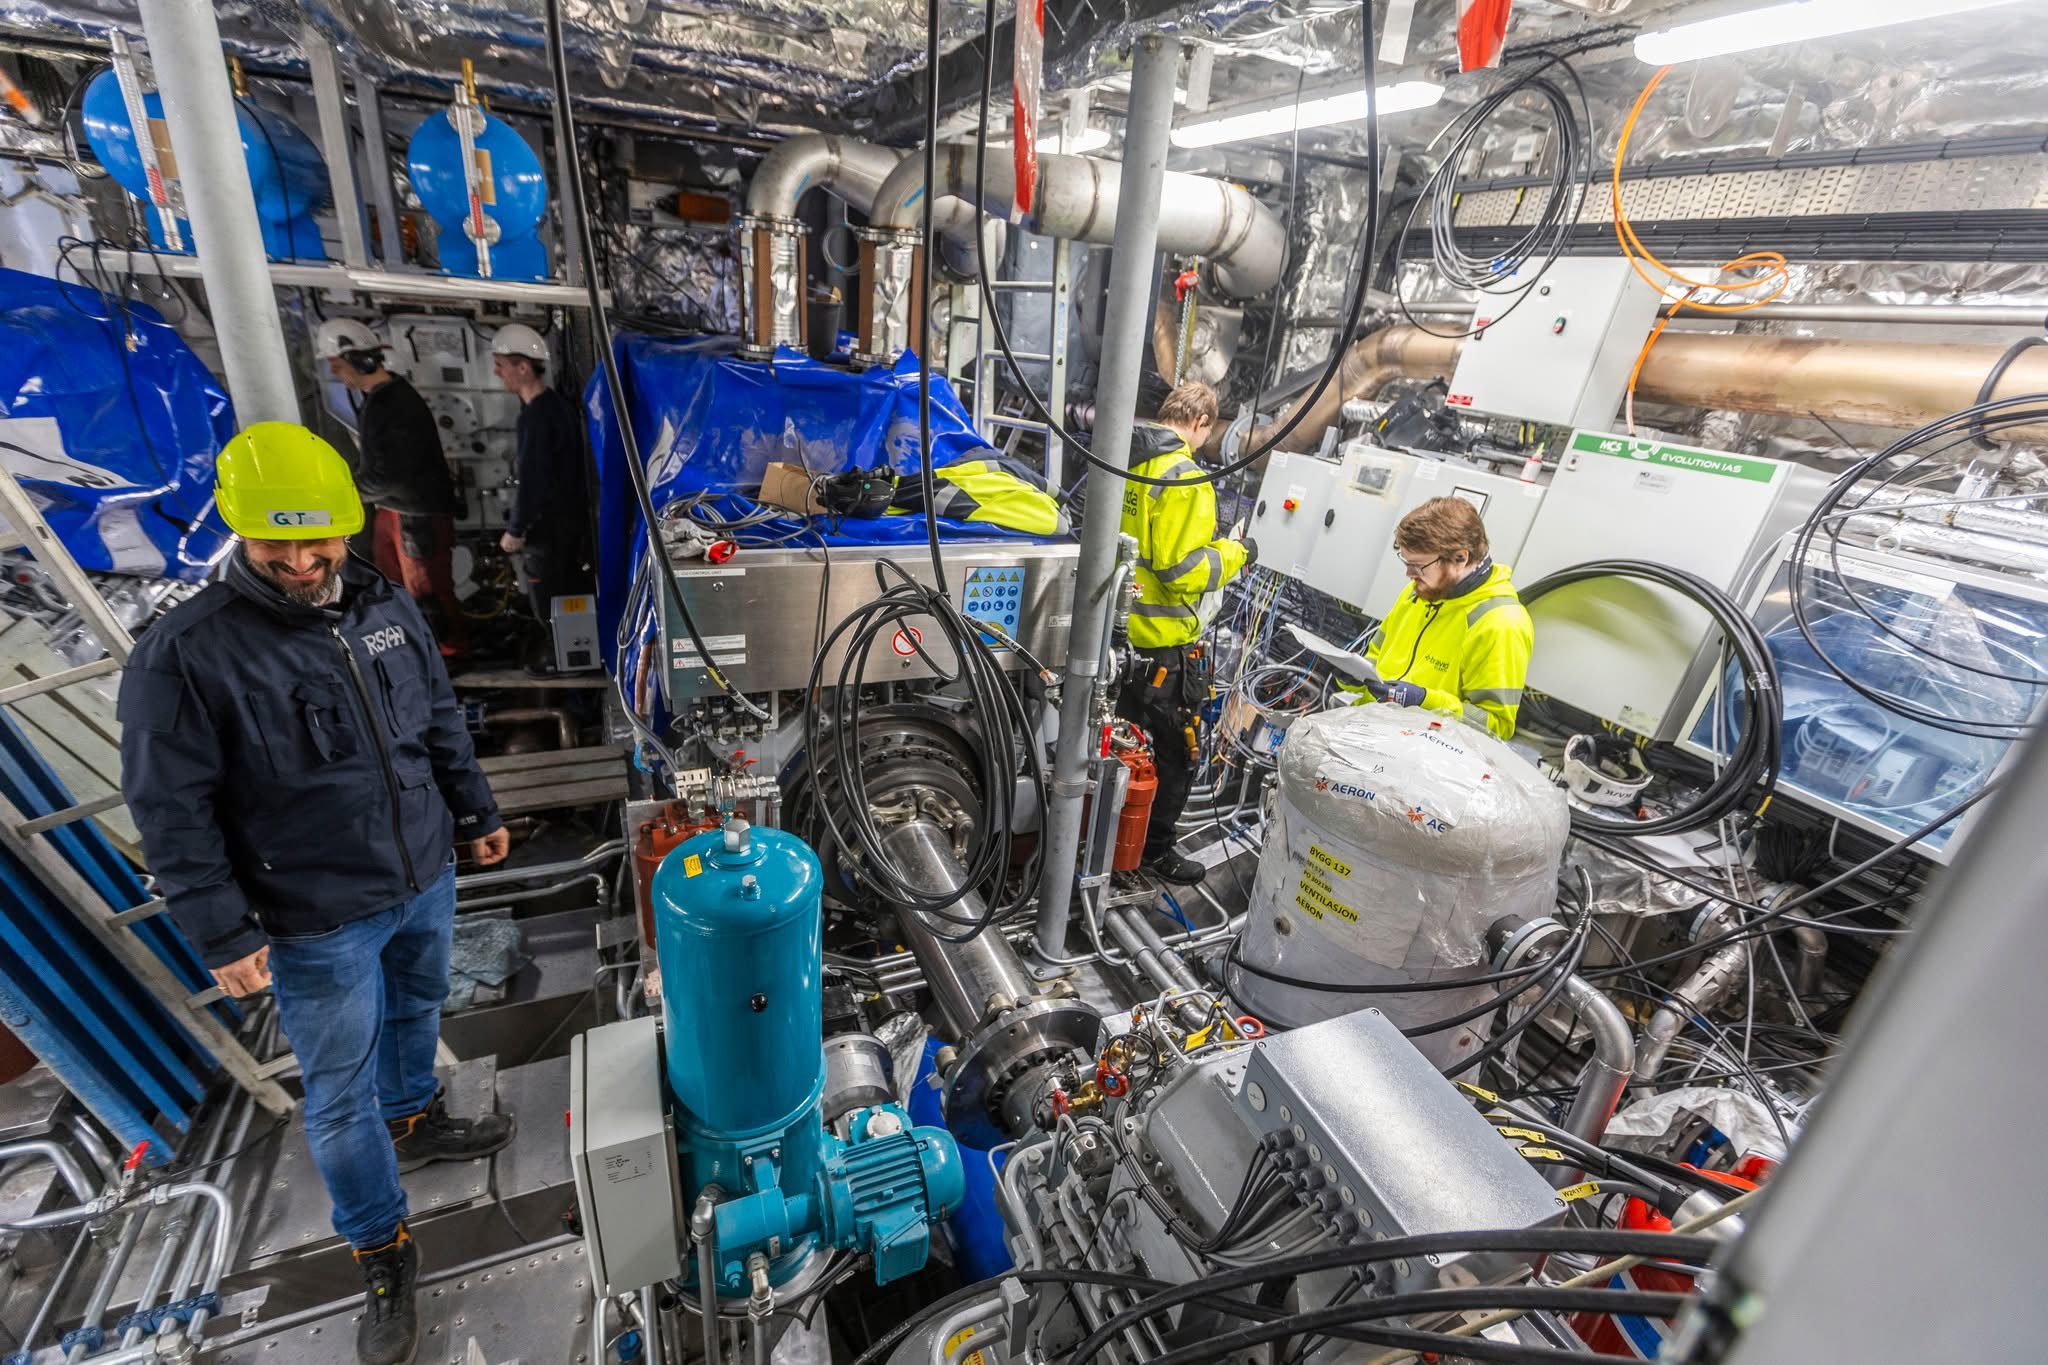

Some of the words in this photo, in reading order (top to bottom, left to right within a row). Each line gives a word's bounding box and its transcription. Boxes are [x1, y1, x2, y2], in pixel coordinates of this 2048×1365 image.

[1599, 439, 1623, 452] MCS
[1660, 453, 1722, 471] EVOLUTION
[1721, 463, 1743, 474] IAS
[1419, 731, 1463, 755] AERON
[1331, 783, 1375, 801] AERON
[1309, 846, 1332, 866] BYGG
[1333, 863, 1352, 877] 137
[1303, 870, 1312, 879] PO
[1295, 896, 1324, 920] AERON
[1300, 880, 1358, 922] VENTILASJON
